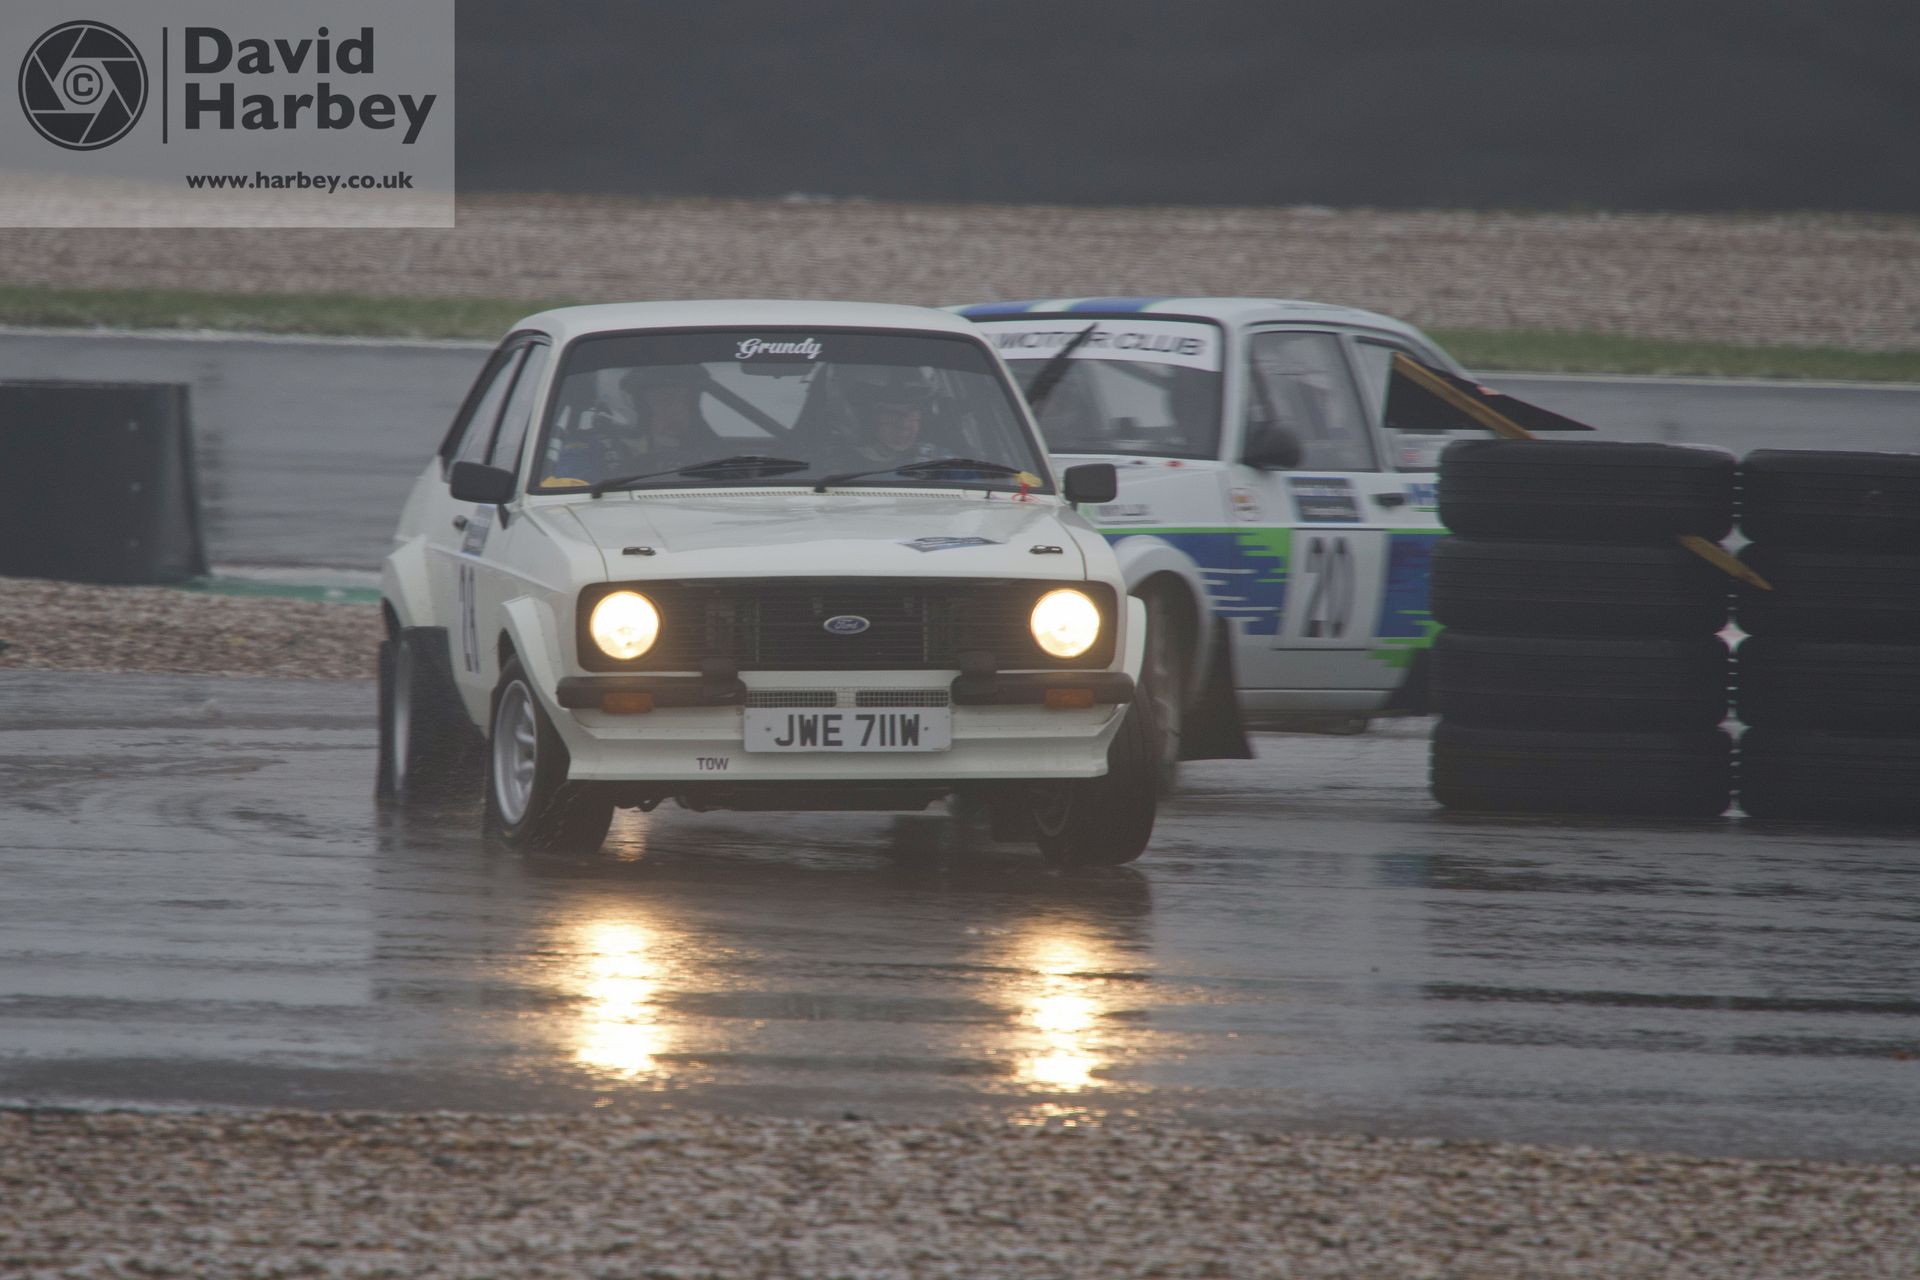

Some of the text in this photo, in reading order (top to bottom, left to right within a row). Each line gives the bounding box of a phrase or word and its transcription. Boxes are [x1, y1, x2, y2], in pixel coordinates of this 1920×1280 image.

[735, 338, 822, 359] Grundy
[1113, 332, 1206, 355] CLUB
[1302, 537, 1354, 638] 20
[774, 714, 920, 747] JWE 711W
[696, 757, 729, 770] TOW
